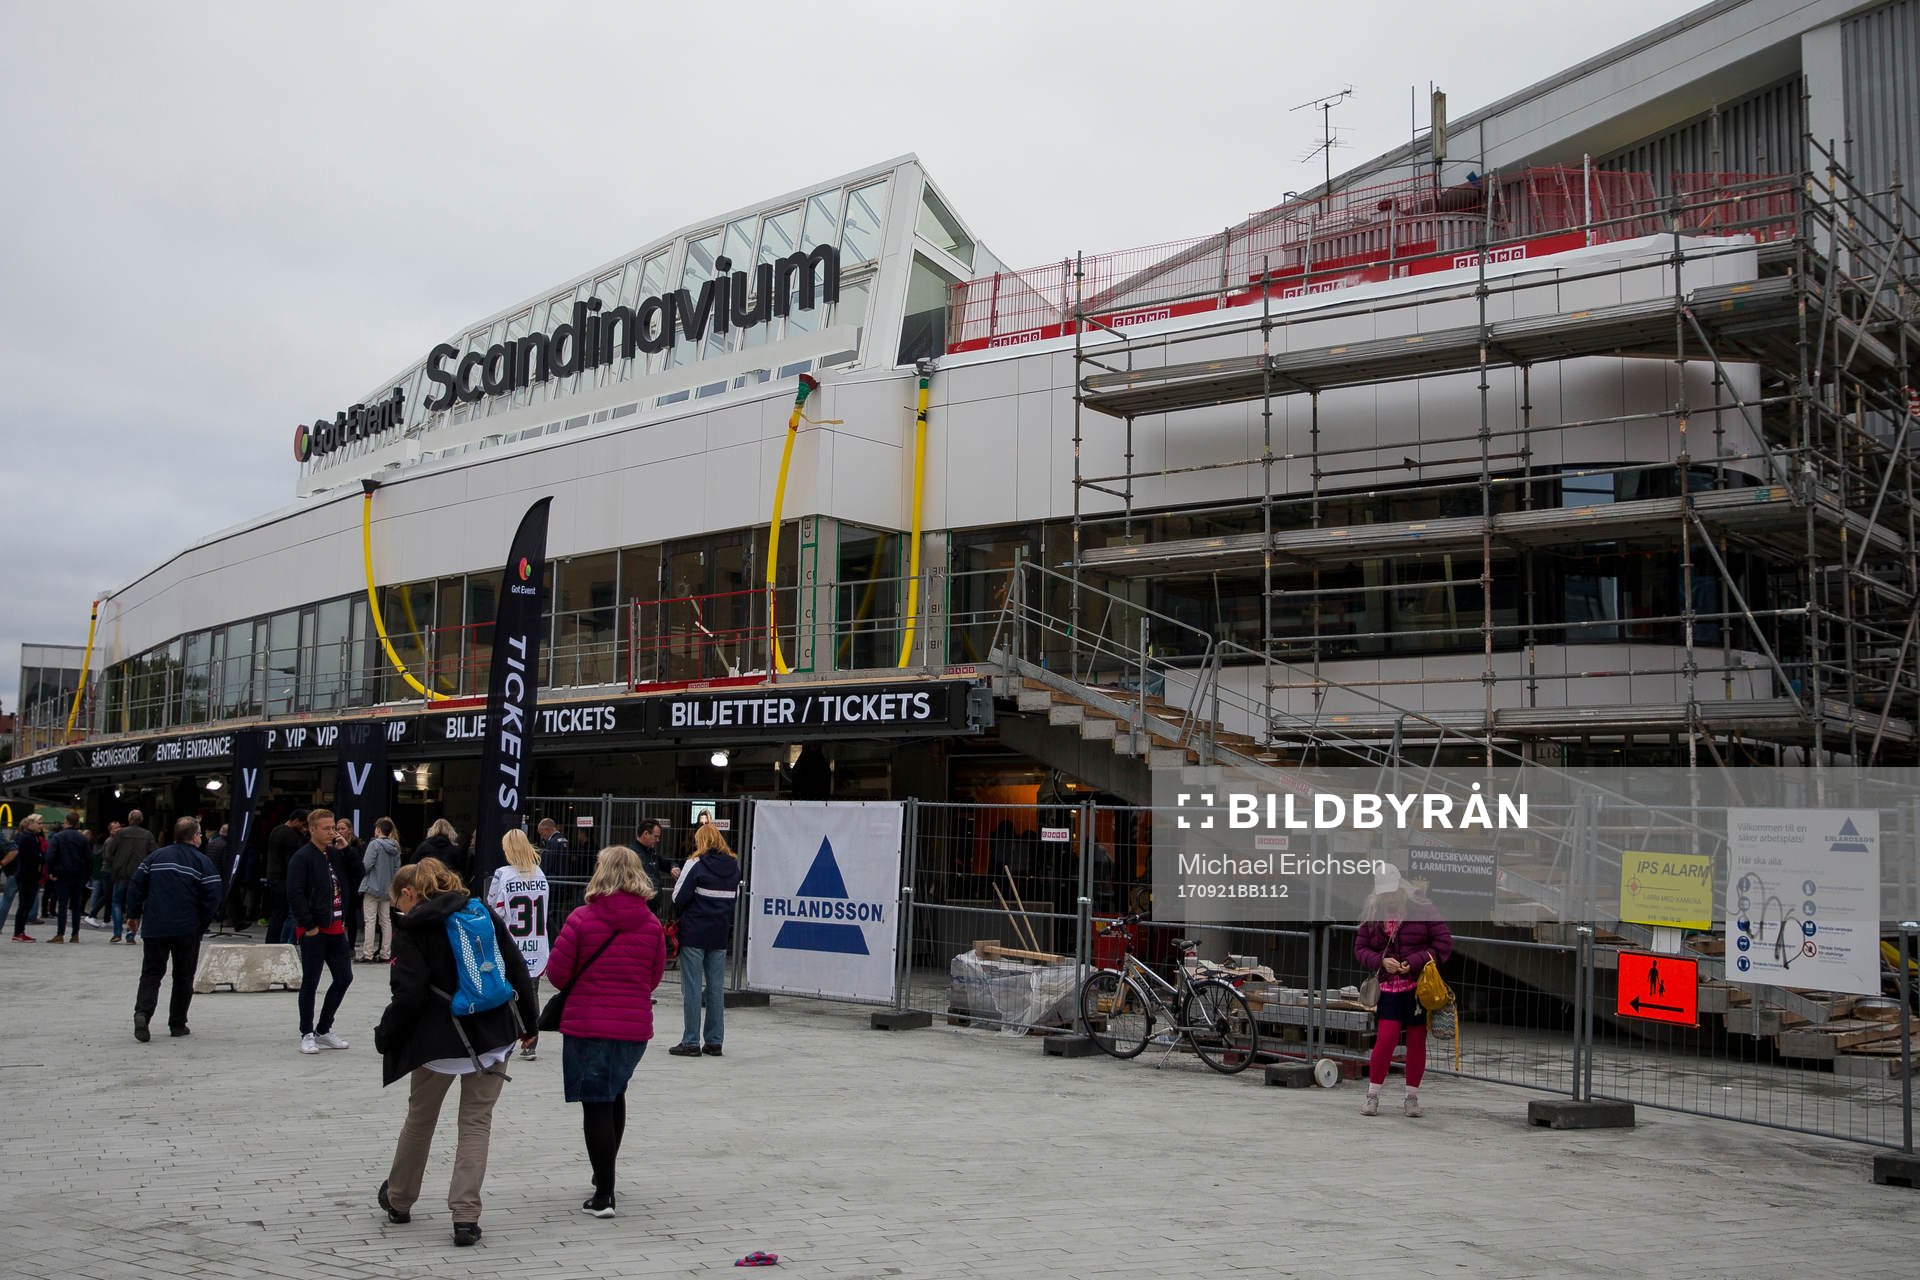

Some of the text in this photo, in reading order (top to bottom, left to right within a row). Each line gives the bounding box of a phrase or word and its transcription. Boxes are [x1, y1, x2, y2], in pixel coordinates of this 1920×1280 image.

[424, 243, 840, 412] Scandinavium
[1115, 313, 1166, 328] CRAMO
[993, 333, 1038, 348] CRAMO
[312, 387, 405, 456] Got Event
[671, 692, 931, 727] BILJETTER / TICKETS
[446, 715, 487, 739] BILJE
[543, 706, 616, 733] TICKETS
[499, 635, 527, 812] TICKETS
[285, 728, 306, 748] VIP
[317, 726, 338, 746] VIP
[156, 738, 181, 761] ENTRÉ
[187, 736, 231, 759] ENTRANCE
[1737, 823, 1783, 832] Välkommen
[1785, 824, 1795, 832] till
[1738, 833, 1805, 844] säker arbetsplats!
[1824, 835, 1875, 843] ERLANDSSON
[1411, 850, 1495, 864] OMRÅDESBEVAKNING
[1738, 856, 1783, 866] Här ska alla:
[1411, 861, 1418, 870] &
[1420, 862, 1493, 875] LARMUTRYCKNING
[1637, 860, 1710, 878] IPS ALARM
[505, 880, 547, 893] SERNEKE
[1661, 895, 1675, 903] MED
[1676, 897, 1702, 905] KAMERA
[508, 894, 546, 937] 31
[763, 897, 884, 923] ERLANDSSON
